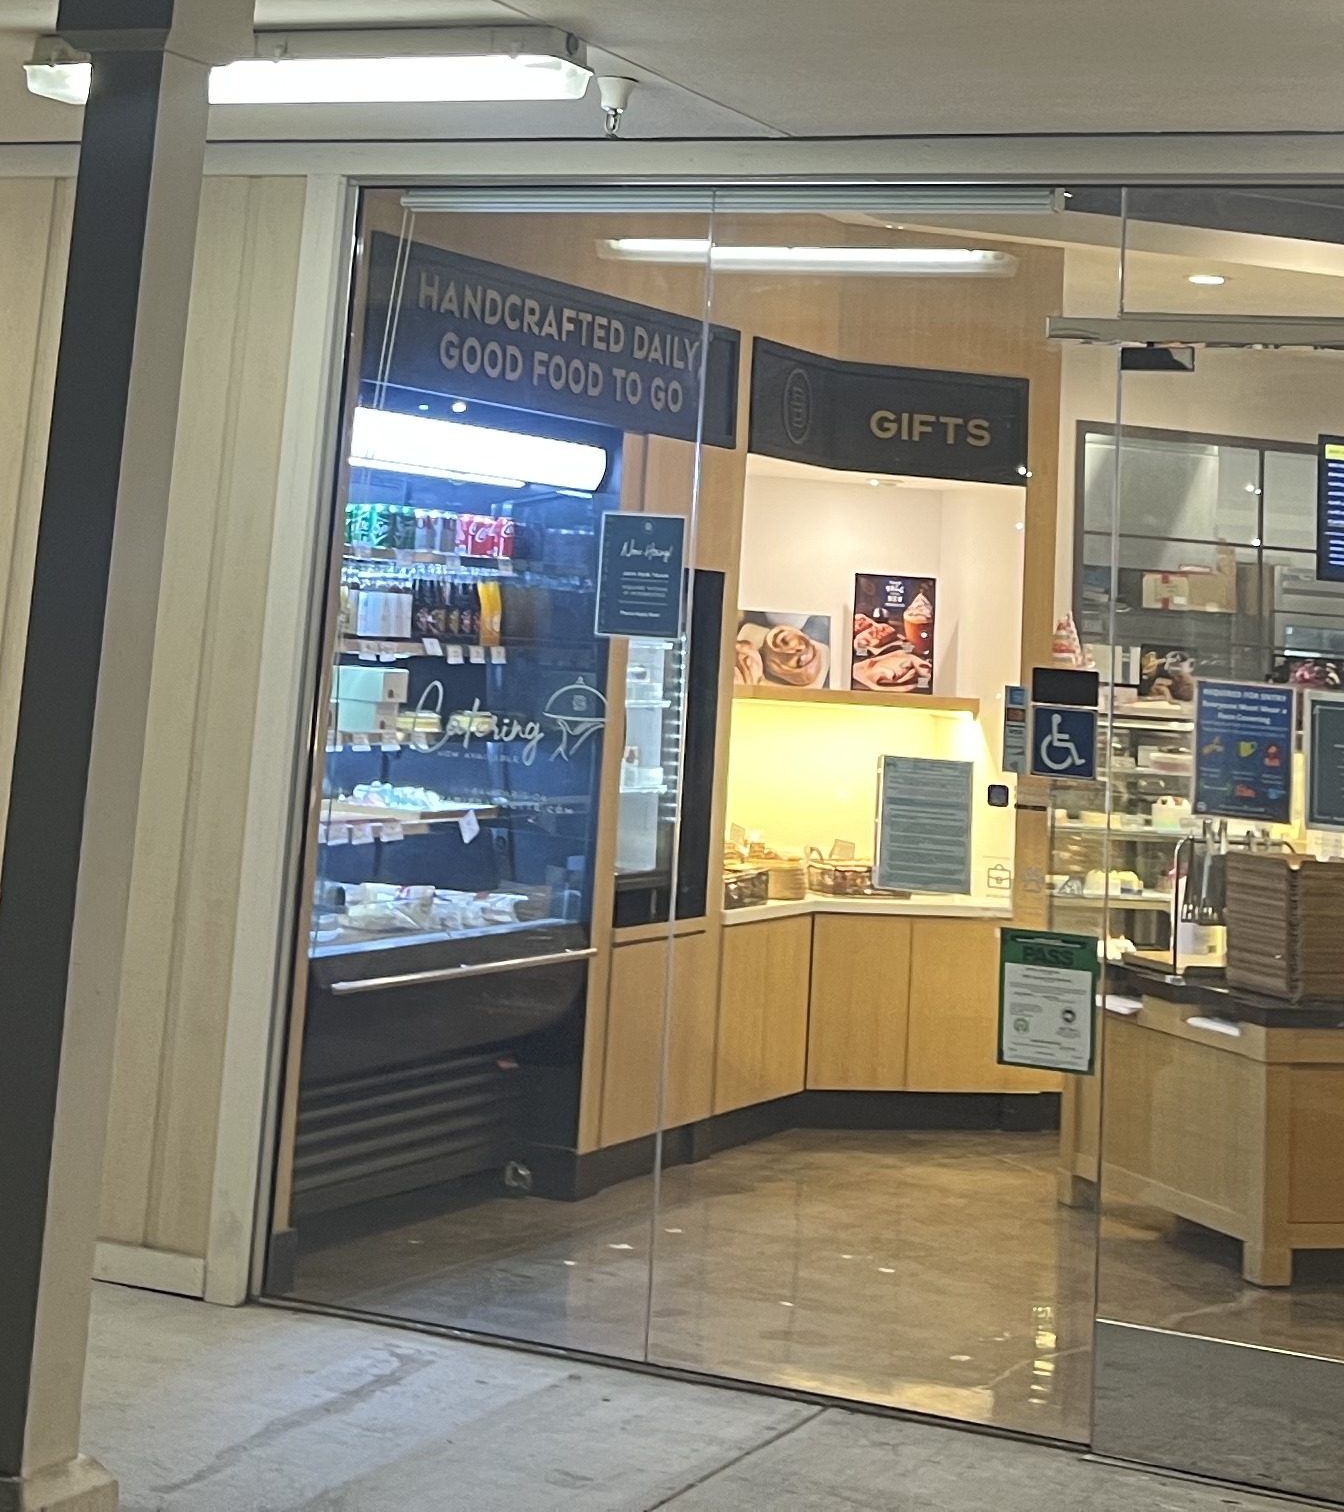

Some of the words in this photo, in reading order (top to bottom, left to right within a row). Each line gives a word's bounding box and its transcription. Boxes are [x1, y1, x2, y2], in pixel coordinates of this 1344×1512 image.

[419, 272, 625, 353] HANDCRAFTED
[633, 326, 700, 371] DAILY
[440, 332, 523, 381] GOOD
[533, 351, 603, 397] FOOD
[613, 368, 641, 405] TO
[651, 377, 683, 413] GO
[870, 410, 991, 447] GIFTS
[410, 680, 544, 766] Catering
[1022, 945, 1074, 966] PASS
